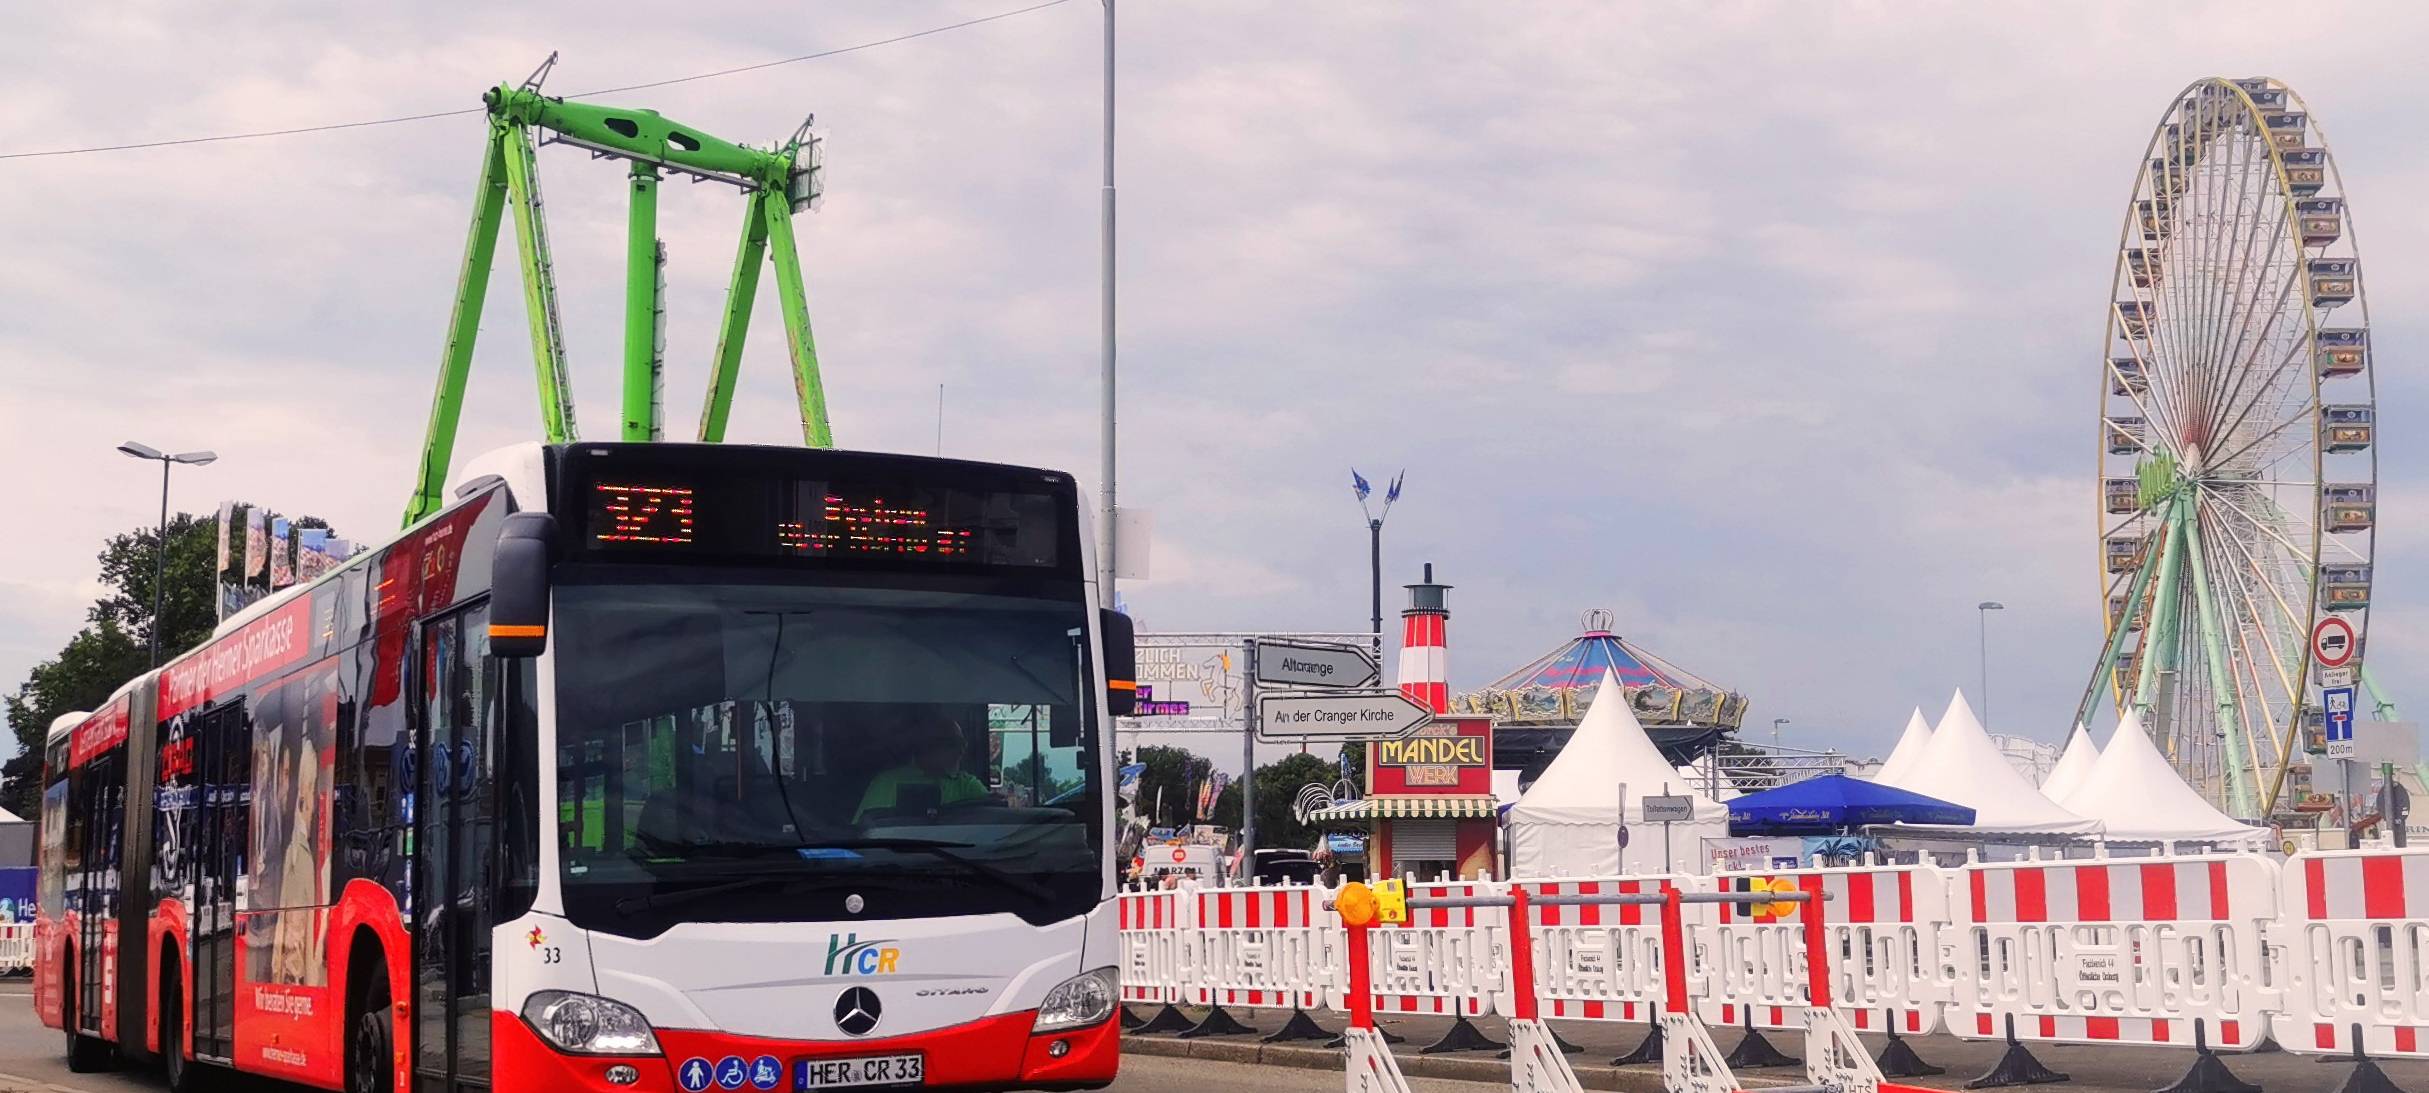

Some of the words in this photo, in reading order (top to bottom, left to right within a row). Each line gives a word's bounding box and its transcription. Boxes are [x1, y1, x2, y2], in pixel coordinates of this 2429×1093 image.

[597, 485, 692, 542] 323
[242, 614, 293, 678] Sparkasse
[1275, 711, 1290, 723] An
[1293, 710, 1311, 722] der
[1314, 709, 1357, 726] Cranger
[1360, 708, 1394, 722] Kirche
[1381, 738, 1483, 763] MANDEL
[1409, 765, 1457, 784] WERK
[1711, 847, 1738, 859] Unser
[1739, 844, 1770, 857] bestes
[544, 947, 561, 964] 33
[824, 933, 899, 976] HCR
[810, 1062, 851, 1086] HER
[863, 1059, 890, 1082] CR
[896, 1057, 920, 1079] 33
